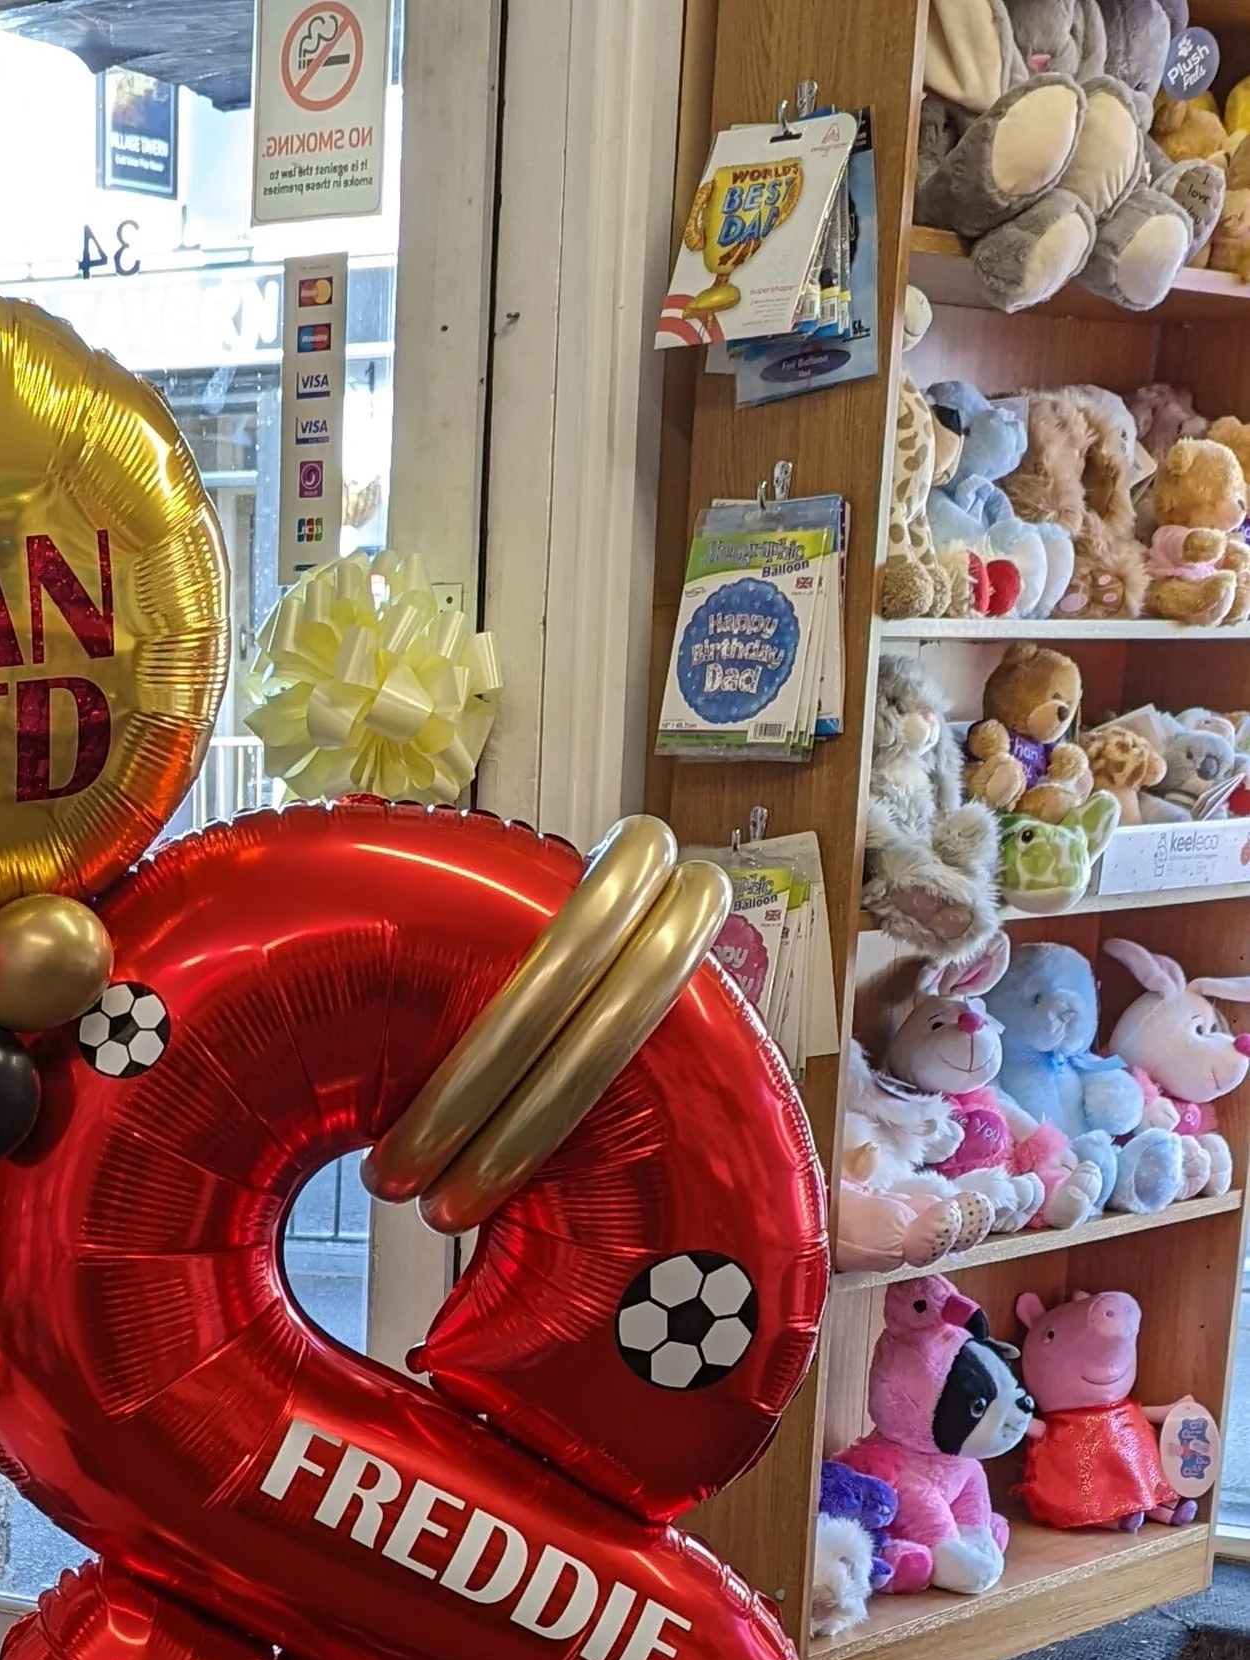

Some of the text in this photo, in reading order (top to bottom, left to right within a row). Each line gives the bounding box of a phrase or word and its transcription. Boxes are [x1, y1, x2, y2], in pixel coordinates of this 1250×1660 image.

[1167, 43, 1210, 85] Plush
[1183, 65, 1207, 91] Pals
[732, 162, 800, 184] WORLD'S
[722, 177, 795, 214] BEST
[301, 374, 329, 389] VISA
[300, 420, 328, 434] VISA
[762, 560, 810, 578] Balloon
[708, 612, 780, 639] Happy
[691, 639, 785, 670] Birthday
[704, 662, 762, 694] Dad
[1170, 831, 1219, 852] keeleco
[734, 893, 779, 912] Balloon
